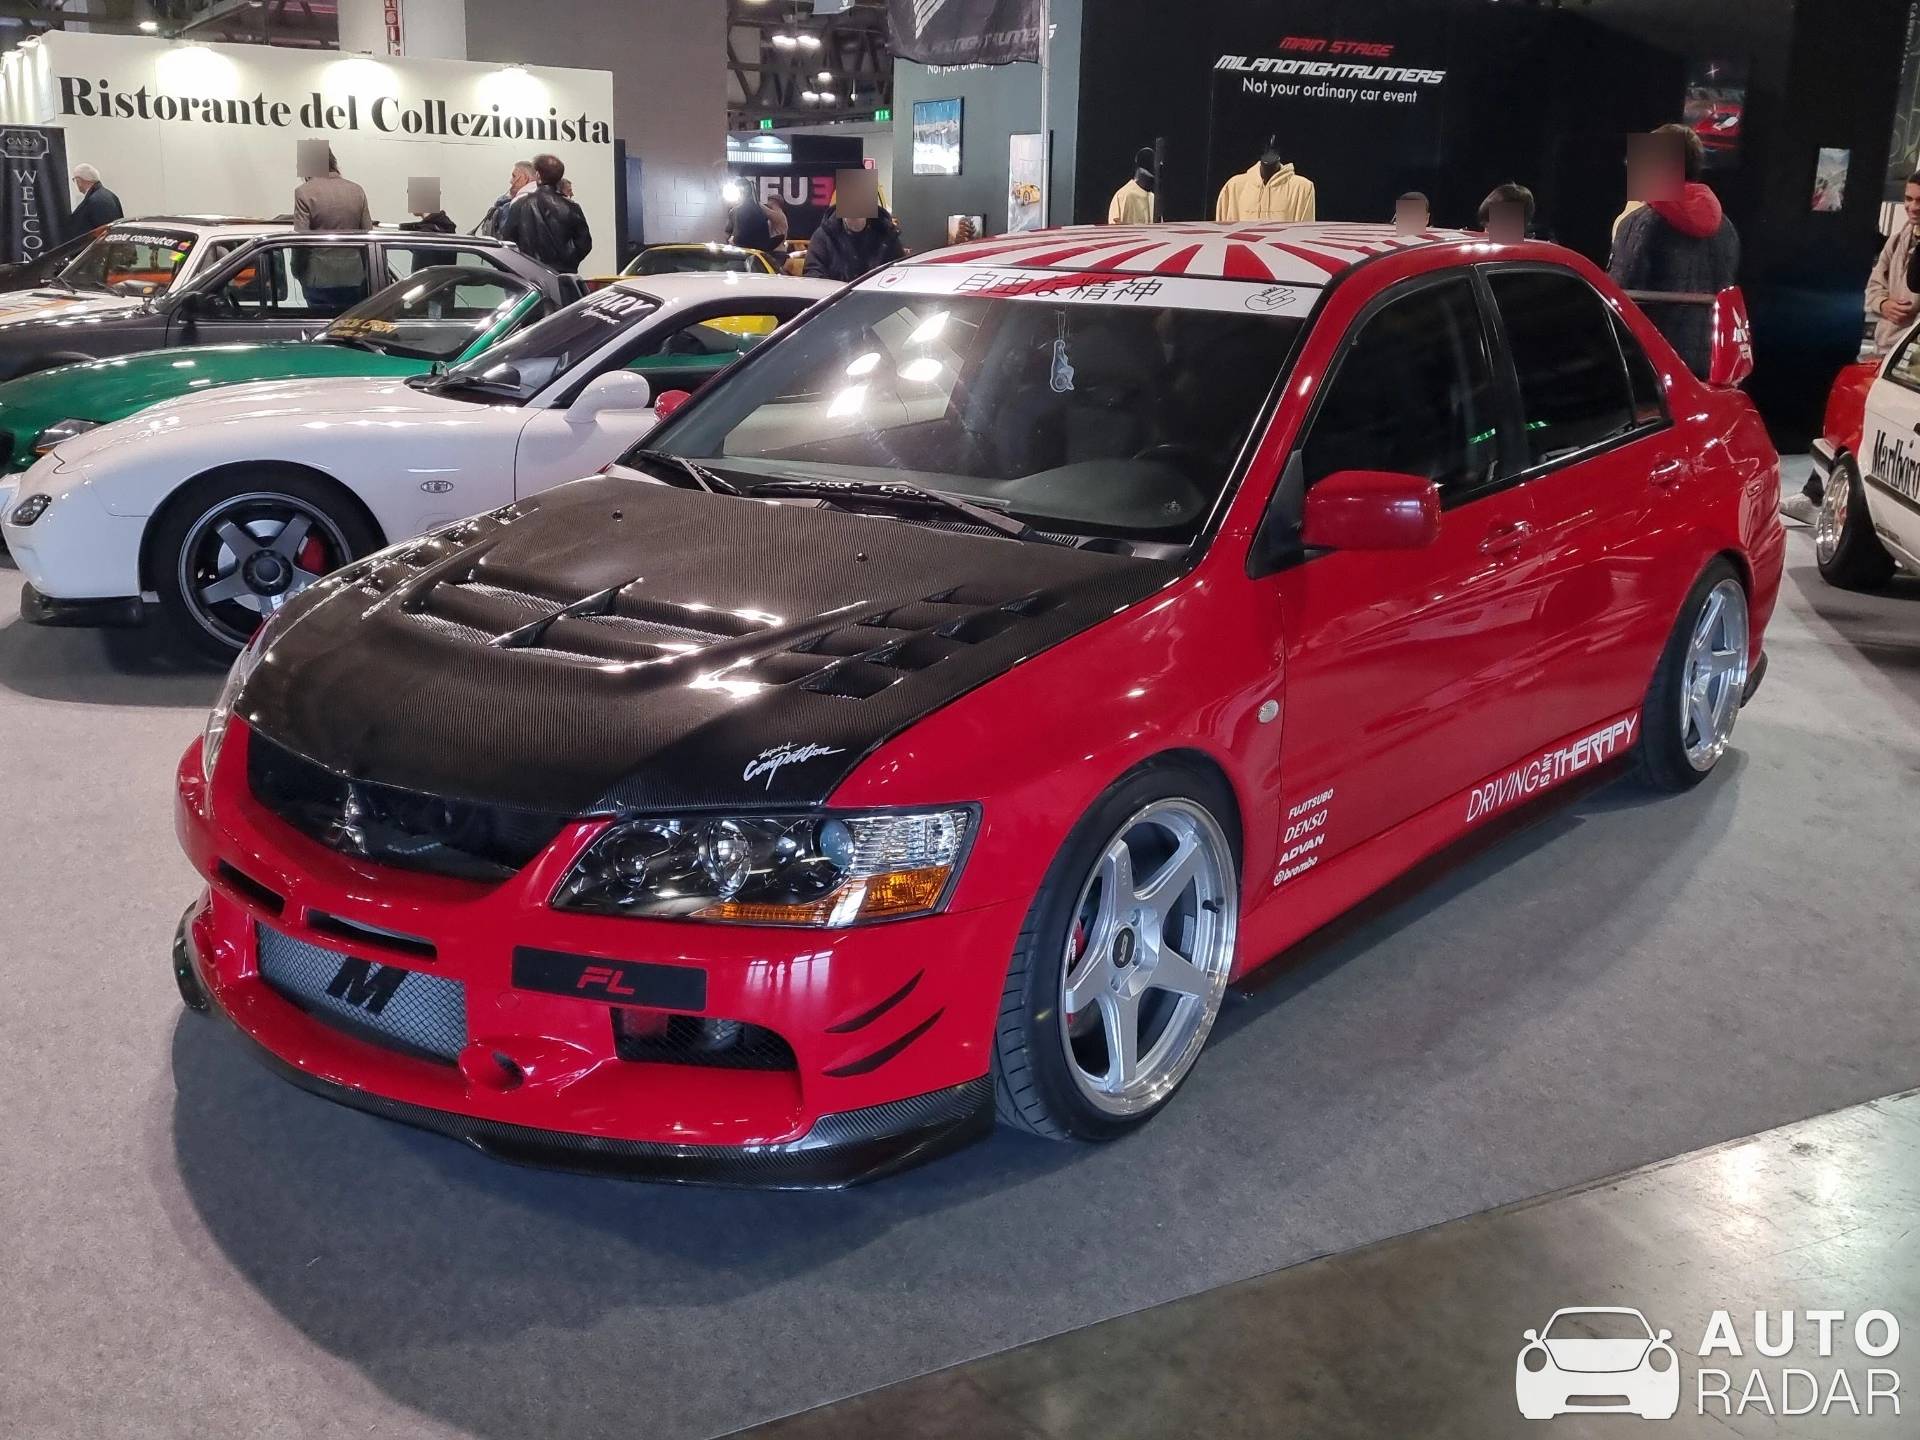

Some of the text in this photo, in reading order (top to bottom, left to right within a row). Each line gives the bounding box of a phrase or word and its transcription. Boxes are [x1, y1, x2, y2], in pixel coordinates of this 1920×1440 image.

[1279, 36, 1394, 57] MAIN STAGE
[1214, 54, 1446, 84] MILANONIGHTRUNNERS
[1242, 77, 1418, 103] Not your ordinary car event
[56, 76, 612, 145] Ristorante del Collezionista
[129, 234, 179, 248] computer
[953, 270, 1164, 302] 自由な精神
[1466, 712, 1638, 823] DRIVING IS MY THERAPY
[1288, 788, 1334, 820] FUJITSUBO
[1283, 809, 1328, 844] DENSO
[1279, 833, 1325, 867] ADVAN
[1282, 856, 1318, 882] brembo
[576, 966, 635, 995] FL
